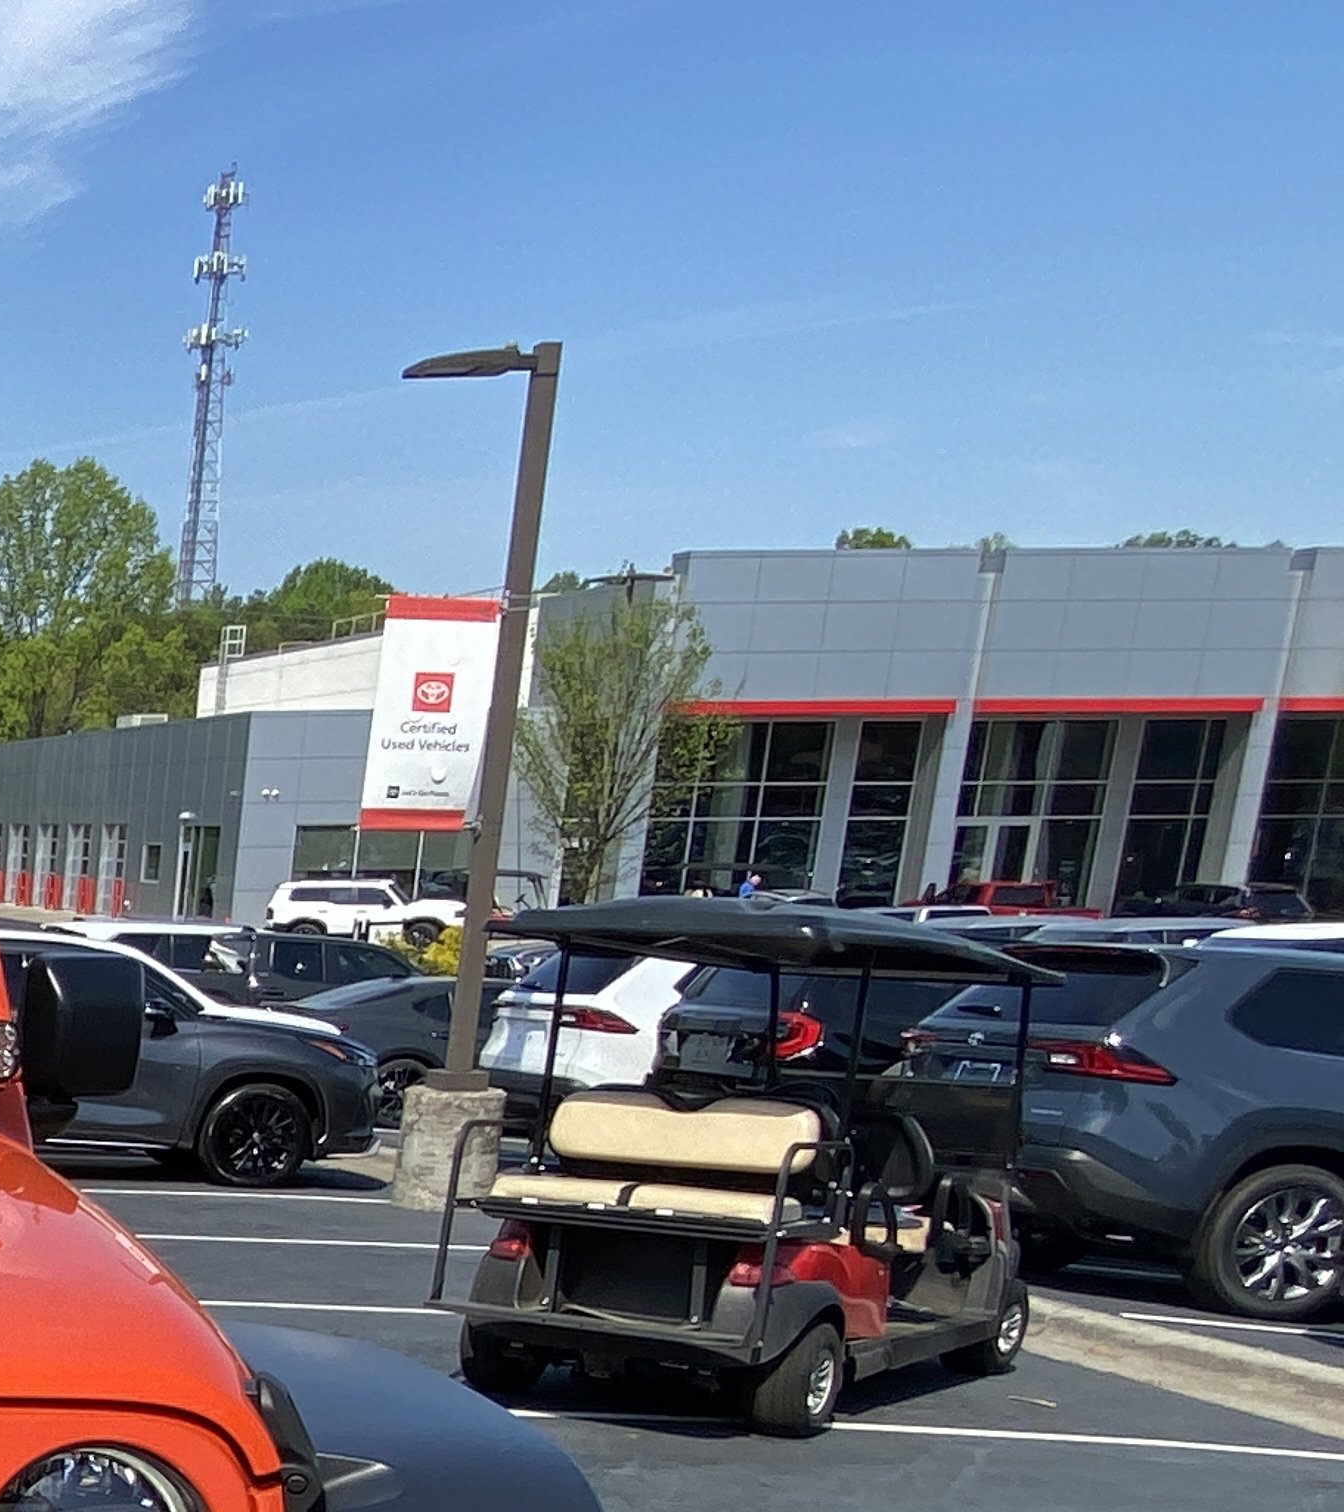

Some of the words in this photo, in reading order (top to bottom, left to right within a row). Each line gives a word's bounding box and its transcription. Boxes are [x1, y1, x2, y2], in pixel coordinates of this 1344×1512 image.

[400, 721, 458, 735] Certified
[381, 739, 415, 750] Used
[418, 739, 470, 753] Vehicles
